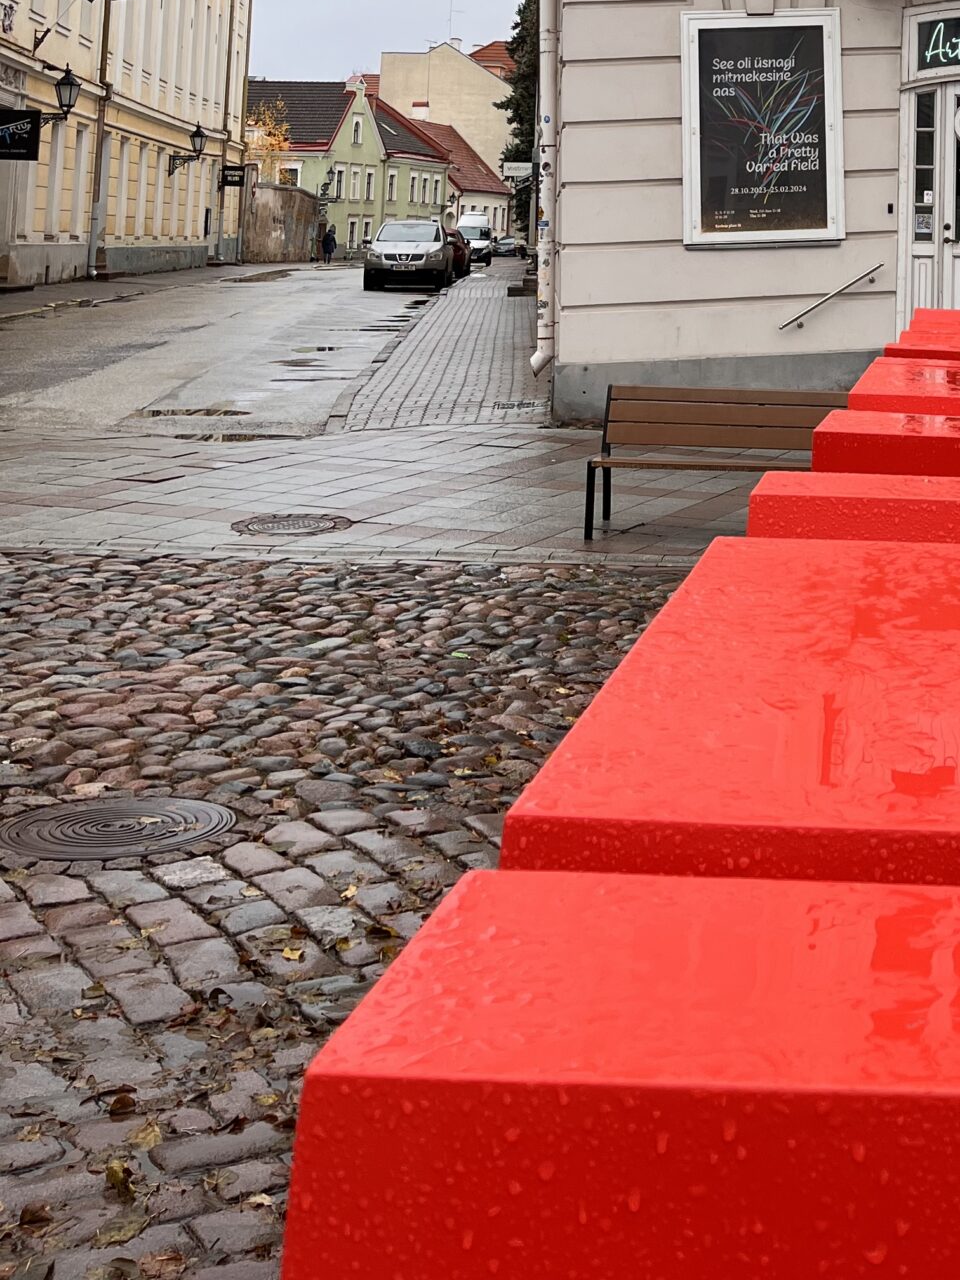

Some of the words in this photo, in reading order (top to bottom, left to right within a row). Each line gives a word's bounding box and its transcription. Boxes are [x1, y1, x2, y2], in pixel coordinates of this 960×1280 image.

[712, 58, 734, 70] See
[737, 57, 751, 69] oli
[754, 56, 795, 71] üsnagi
[712, 70, 791, 83] mitmekesine
[712, 87, 736, 97] aas
[760, 133, 789, 145] That
[791, 132, 819, 143] Was
[768, 148, 777, 158] a
[780, 146, 819, 160] Pretty
[746, 159, 788, 173] Varied
